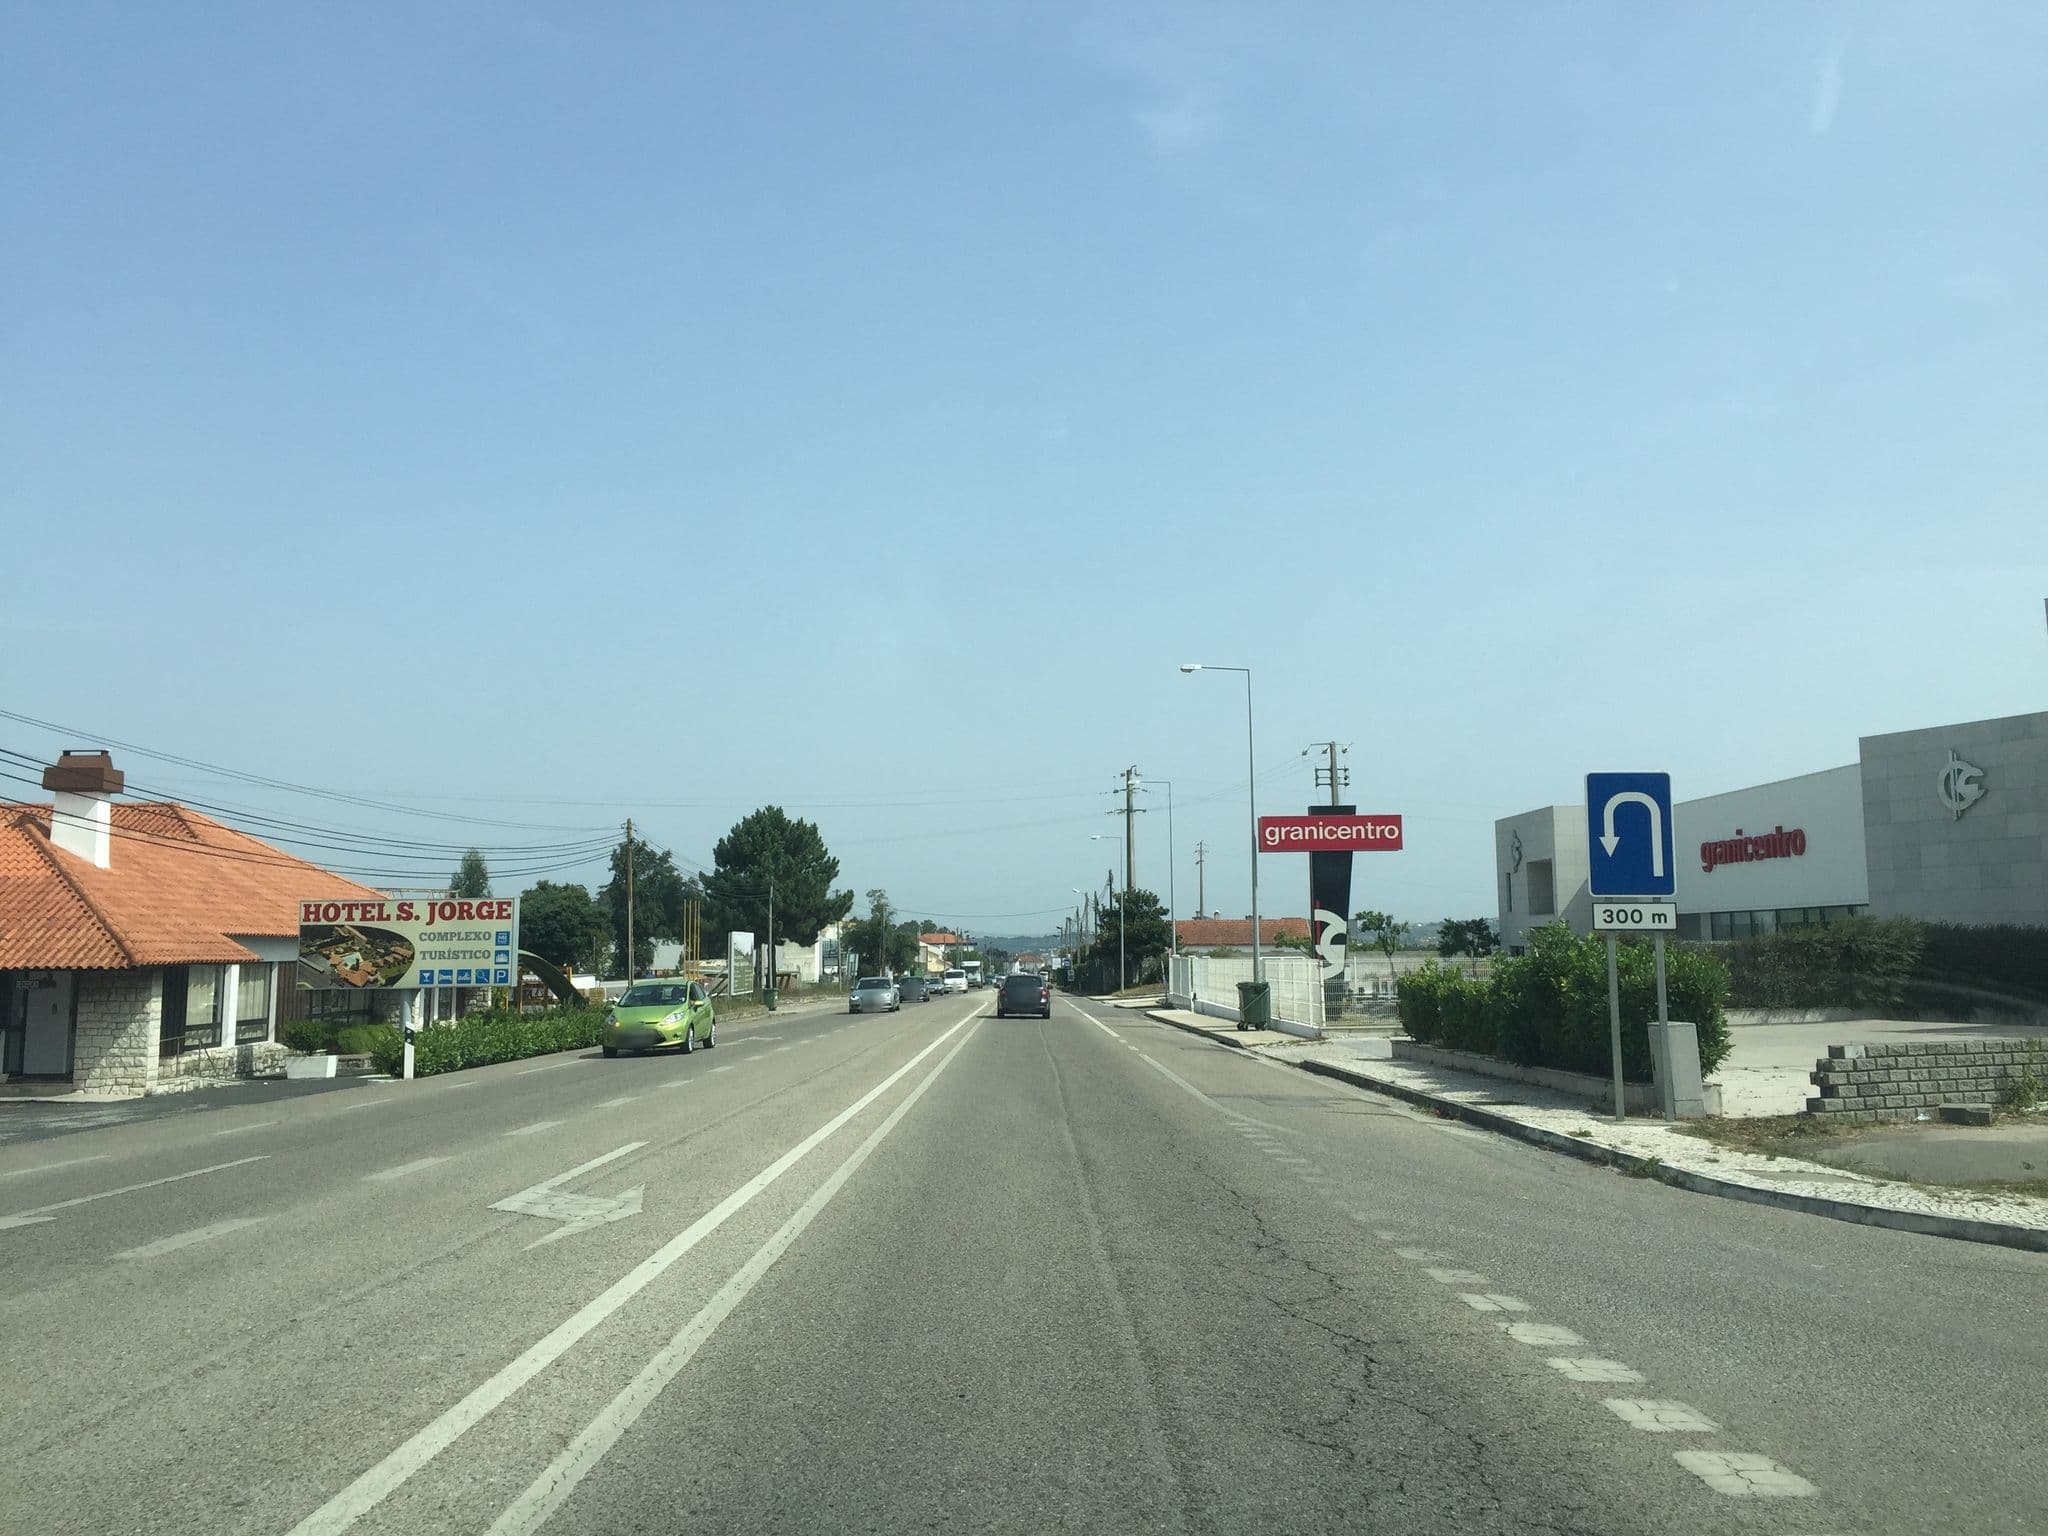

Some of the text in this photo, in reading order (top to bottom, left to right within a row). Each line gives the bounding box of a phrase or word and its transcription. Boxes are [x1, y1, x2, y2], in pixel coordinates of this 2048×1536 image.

[1265, 821, 1399, 846] granicentro
[1700, 825, 1806, 873] granicentro
[302, 900, 512, 925] HOTEL S. JORGE
[1602, 909, 1668, 924] 300 m
[418, 930, 492, 942] COMPLEXO
[419, 948, 491, 961] TURÍSTICO
[496, 970, 507, 983] P
